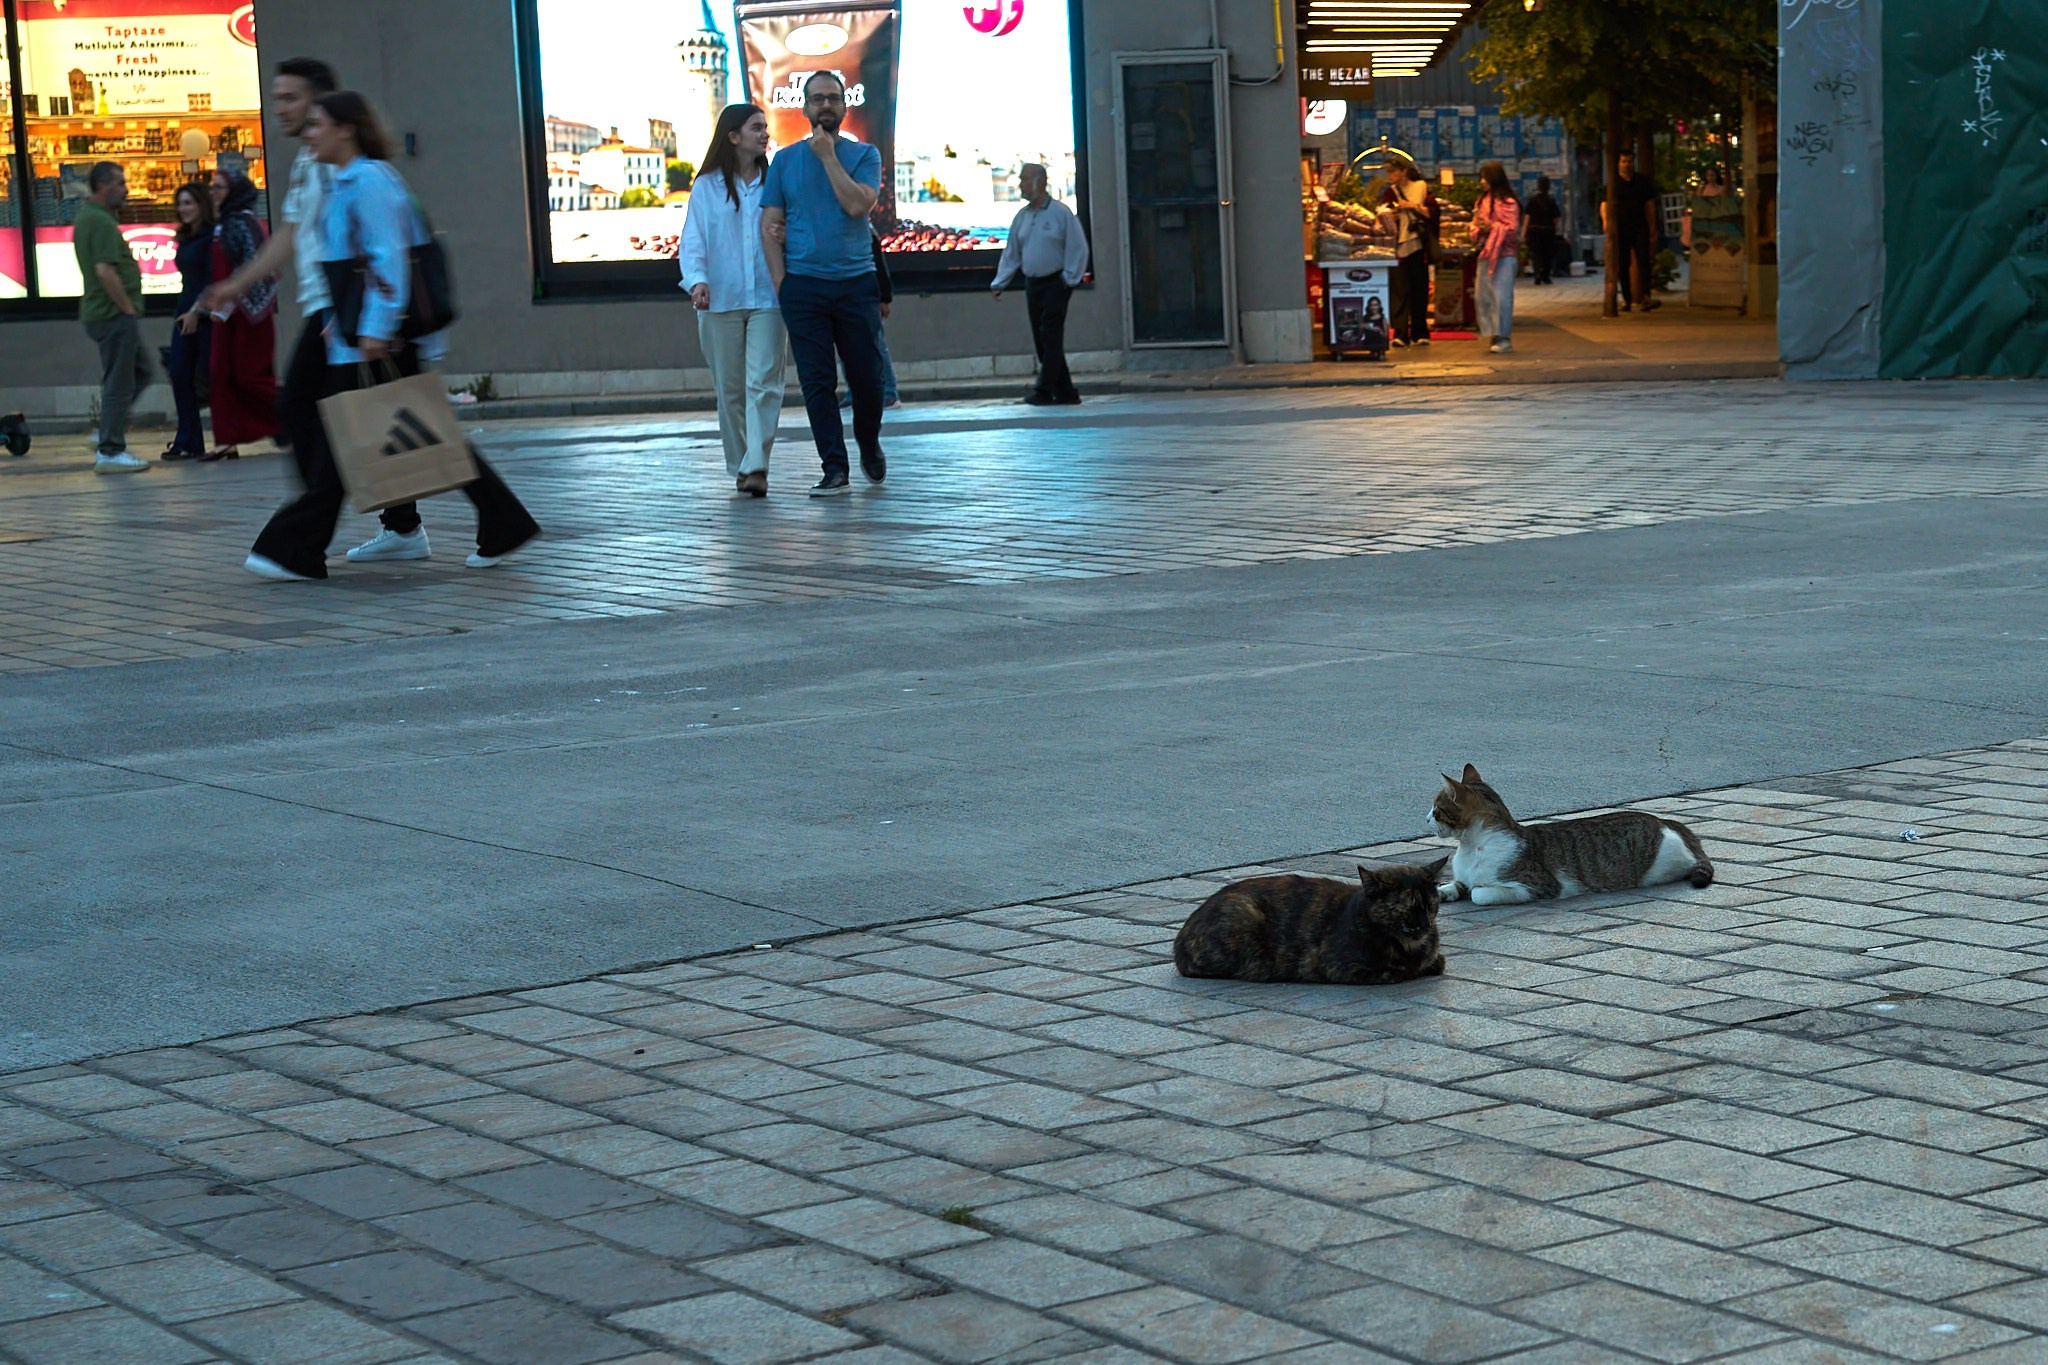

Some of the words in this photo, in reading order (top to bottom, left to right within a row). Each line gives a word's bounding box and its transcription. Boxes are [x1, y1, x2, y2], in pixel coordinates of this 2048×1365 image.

[105, 26, 166, 38] Taptaze
[75, 41, 125, 50] Mutluluk
[116, 53, 158, 64] Fresh
[123, 69, 134, 77] of
[1301, 68, 1325, 81] THE
[1329, 67, 1371, 81] HEZAR
